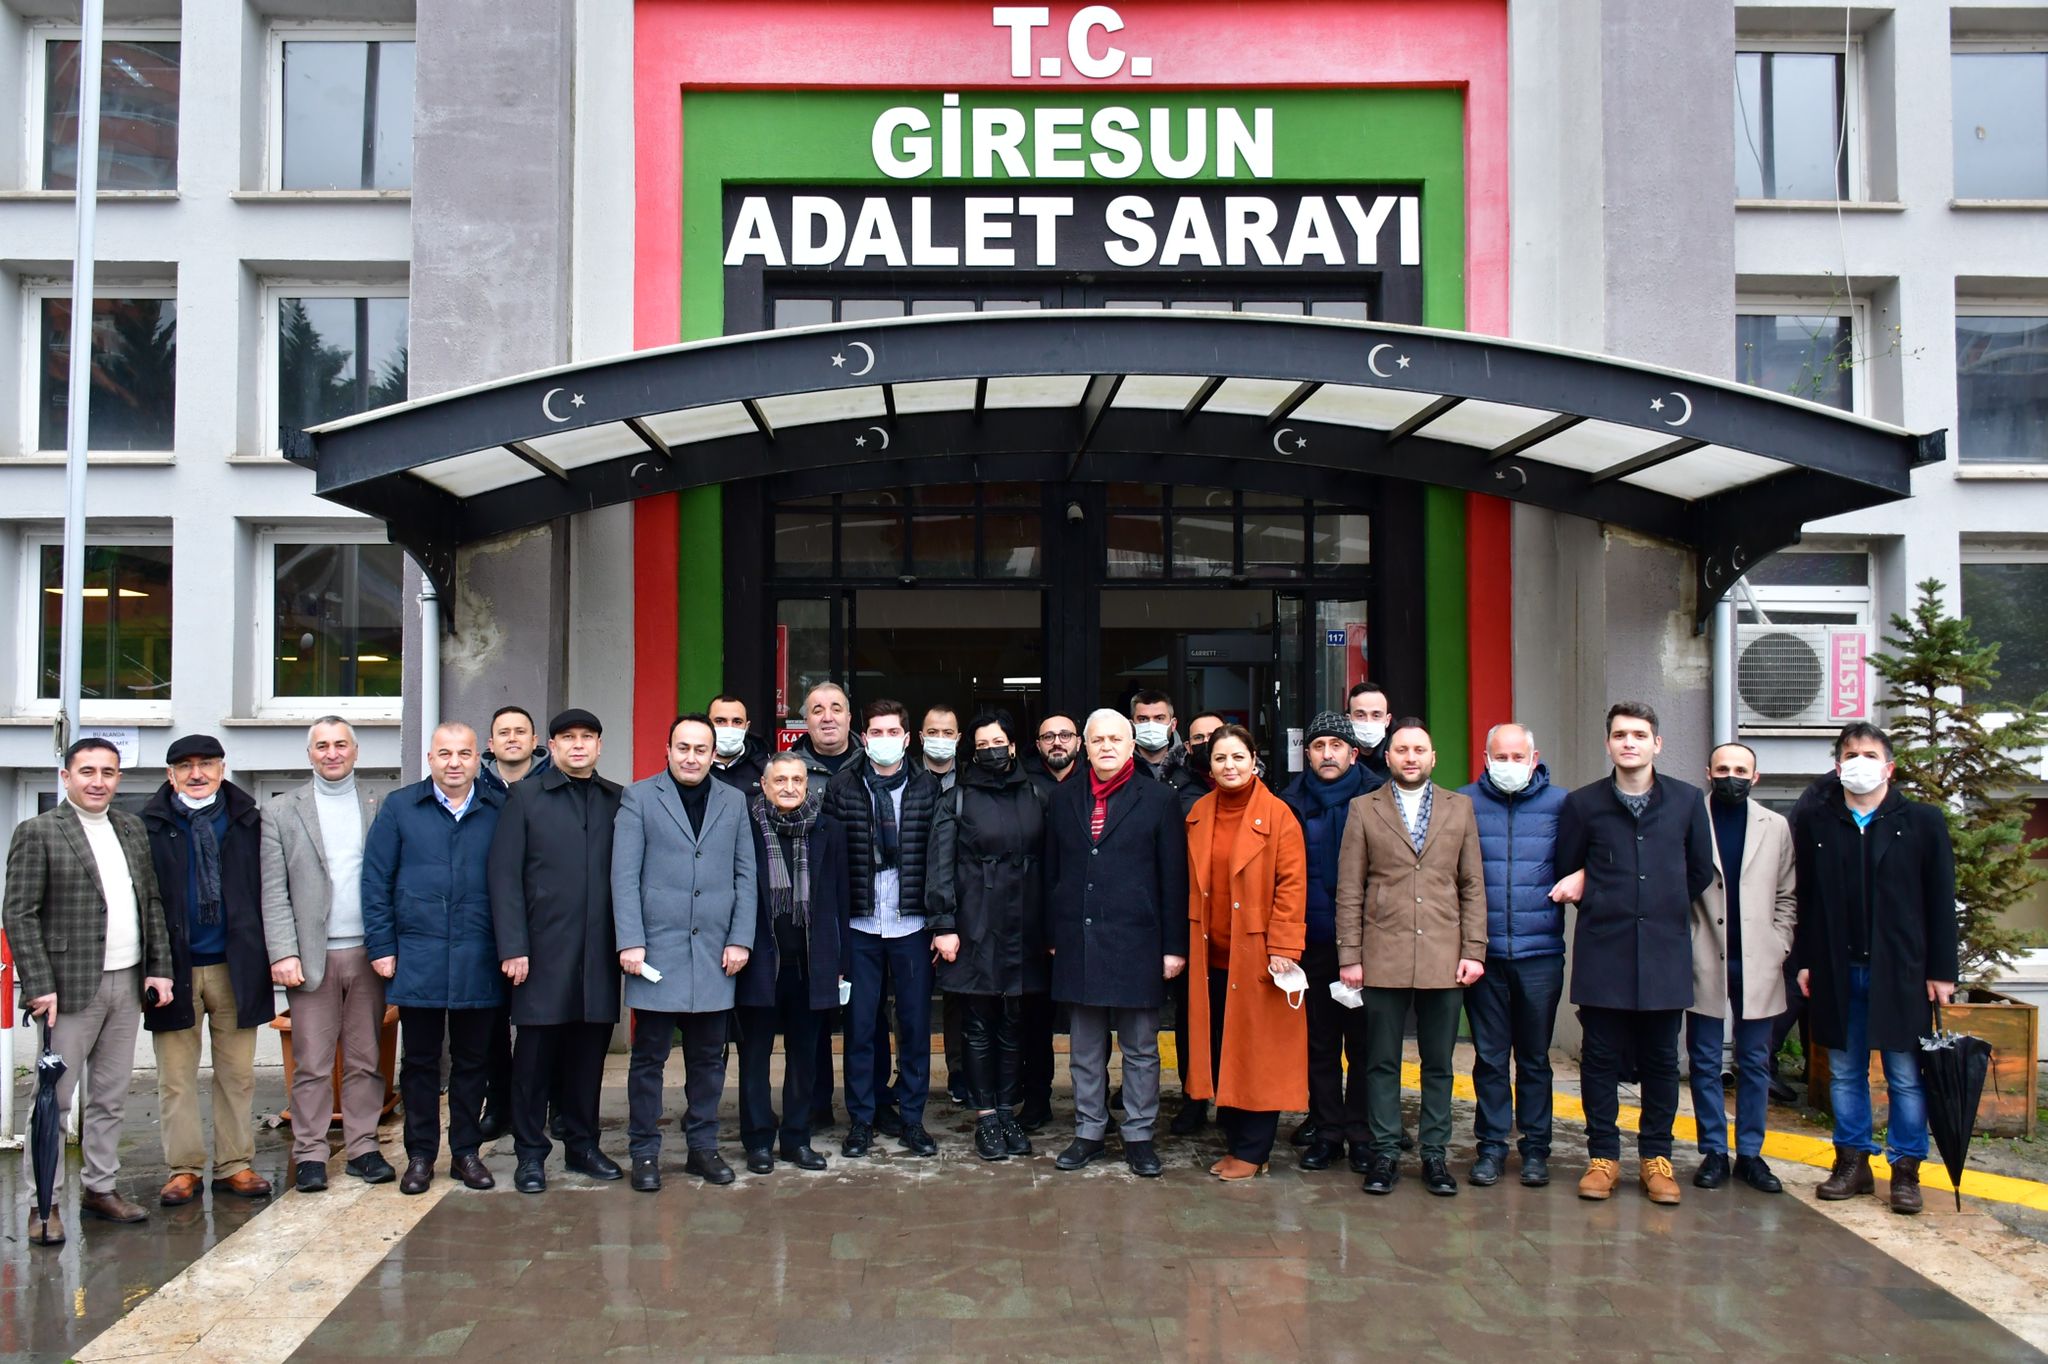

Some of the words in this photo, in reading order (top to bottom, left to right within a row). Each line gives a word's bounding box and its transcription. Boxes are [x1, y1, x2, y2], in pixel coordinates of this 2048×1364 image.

[993, 5, 1154, 78] T.C.
[871, 93, 1274, 179] GİRESUN
[723, 196, 1074, 267] ADALET
[1104, 195, 1421, 267] SARAYI
[1328, 633, 1344, 642] 117
[1838, 633, 1859, 717] VESTEL
